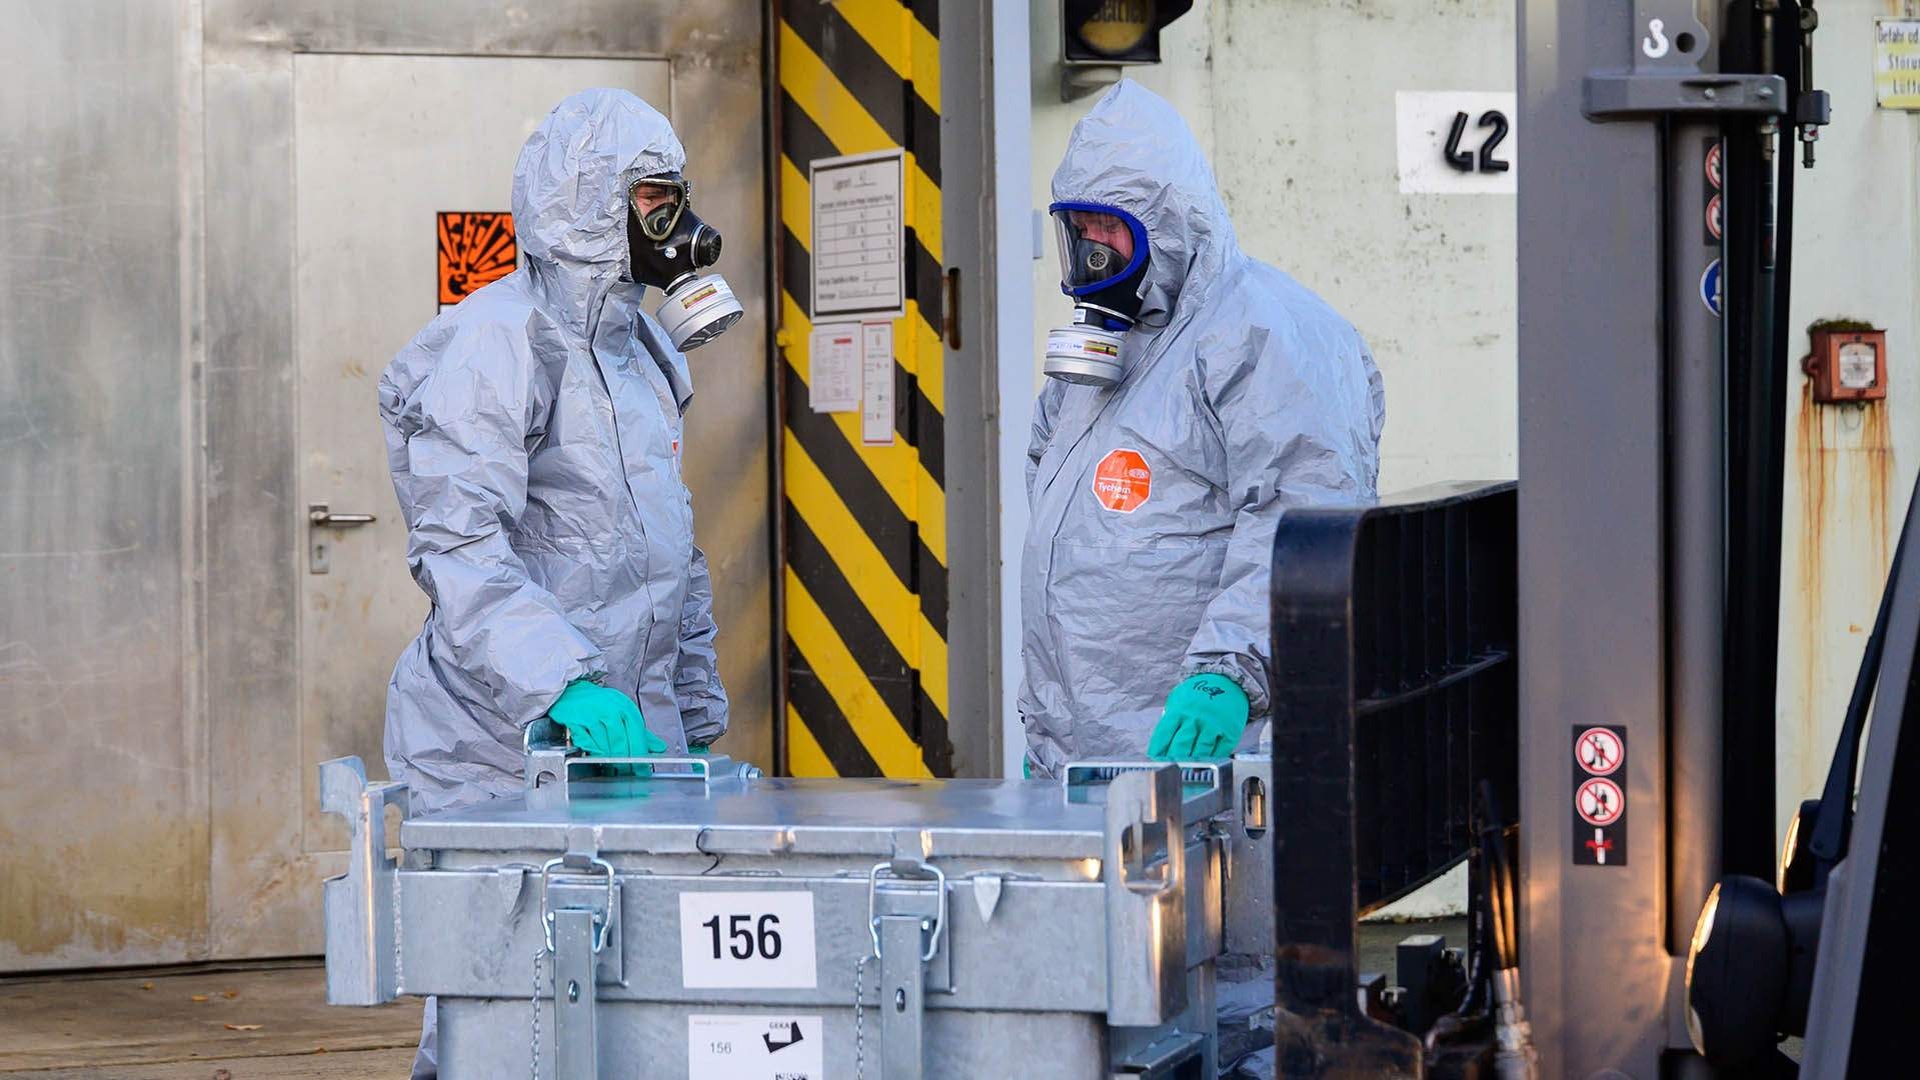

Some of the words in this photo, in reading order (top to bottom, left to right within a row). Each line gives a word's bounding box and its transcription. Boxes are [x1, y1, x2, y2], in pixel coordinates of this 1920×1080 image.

[1445, 110, 1509, 173] 42
[1098, 481, 1131, 494] Tychem
[703, 914, 782, 960] 156
[710, 1041, 732, 1054] 156
